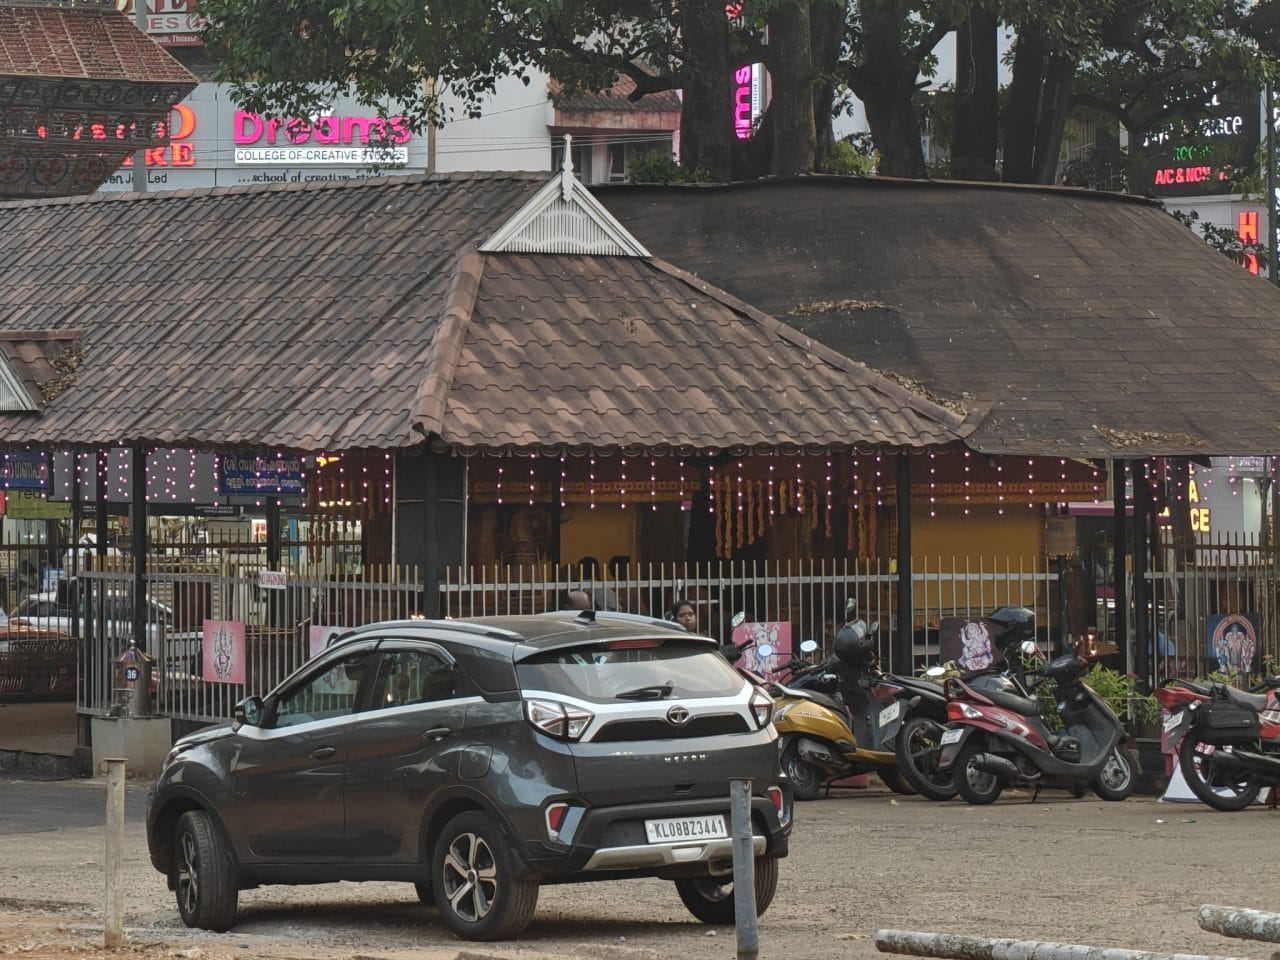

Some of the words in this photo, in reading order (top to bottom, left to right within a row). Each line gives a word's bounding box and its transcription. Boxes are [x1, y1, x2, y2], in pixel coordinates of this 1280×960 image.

[233, 110, 412, 145] Dreams
[236, 150, 285, 161] COLLEGE
[288, 150, 302, 161] OF
[306, 150, 357, 161] CREATIVE
[148, 171, 167, 184] Led
[291, 171, 302, 182] of
[126, 669, 137, 680] 36
[654, 819, 725, 838] KL08BZ3441
